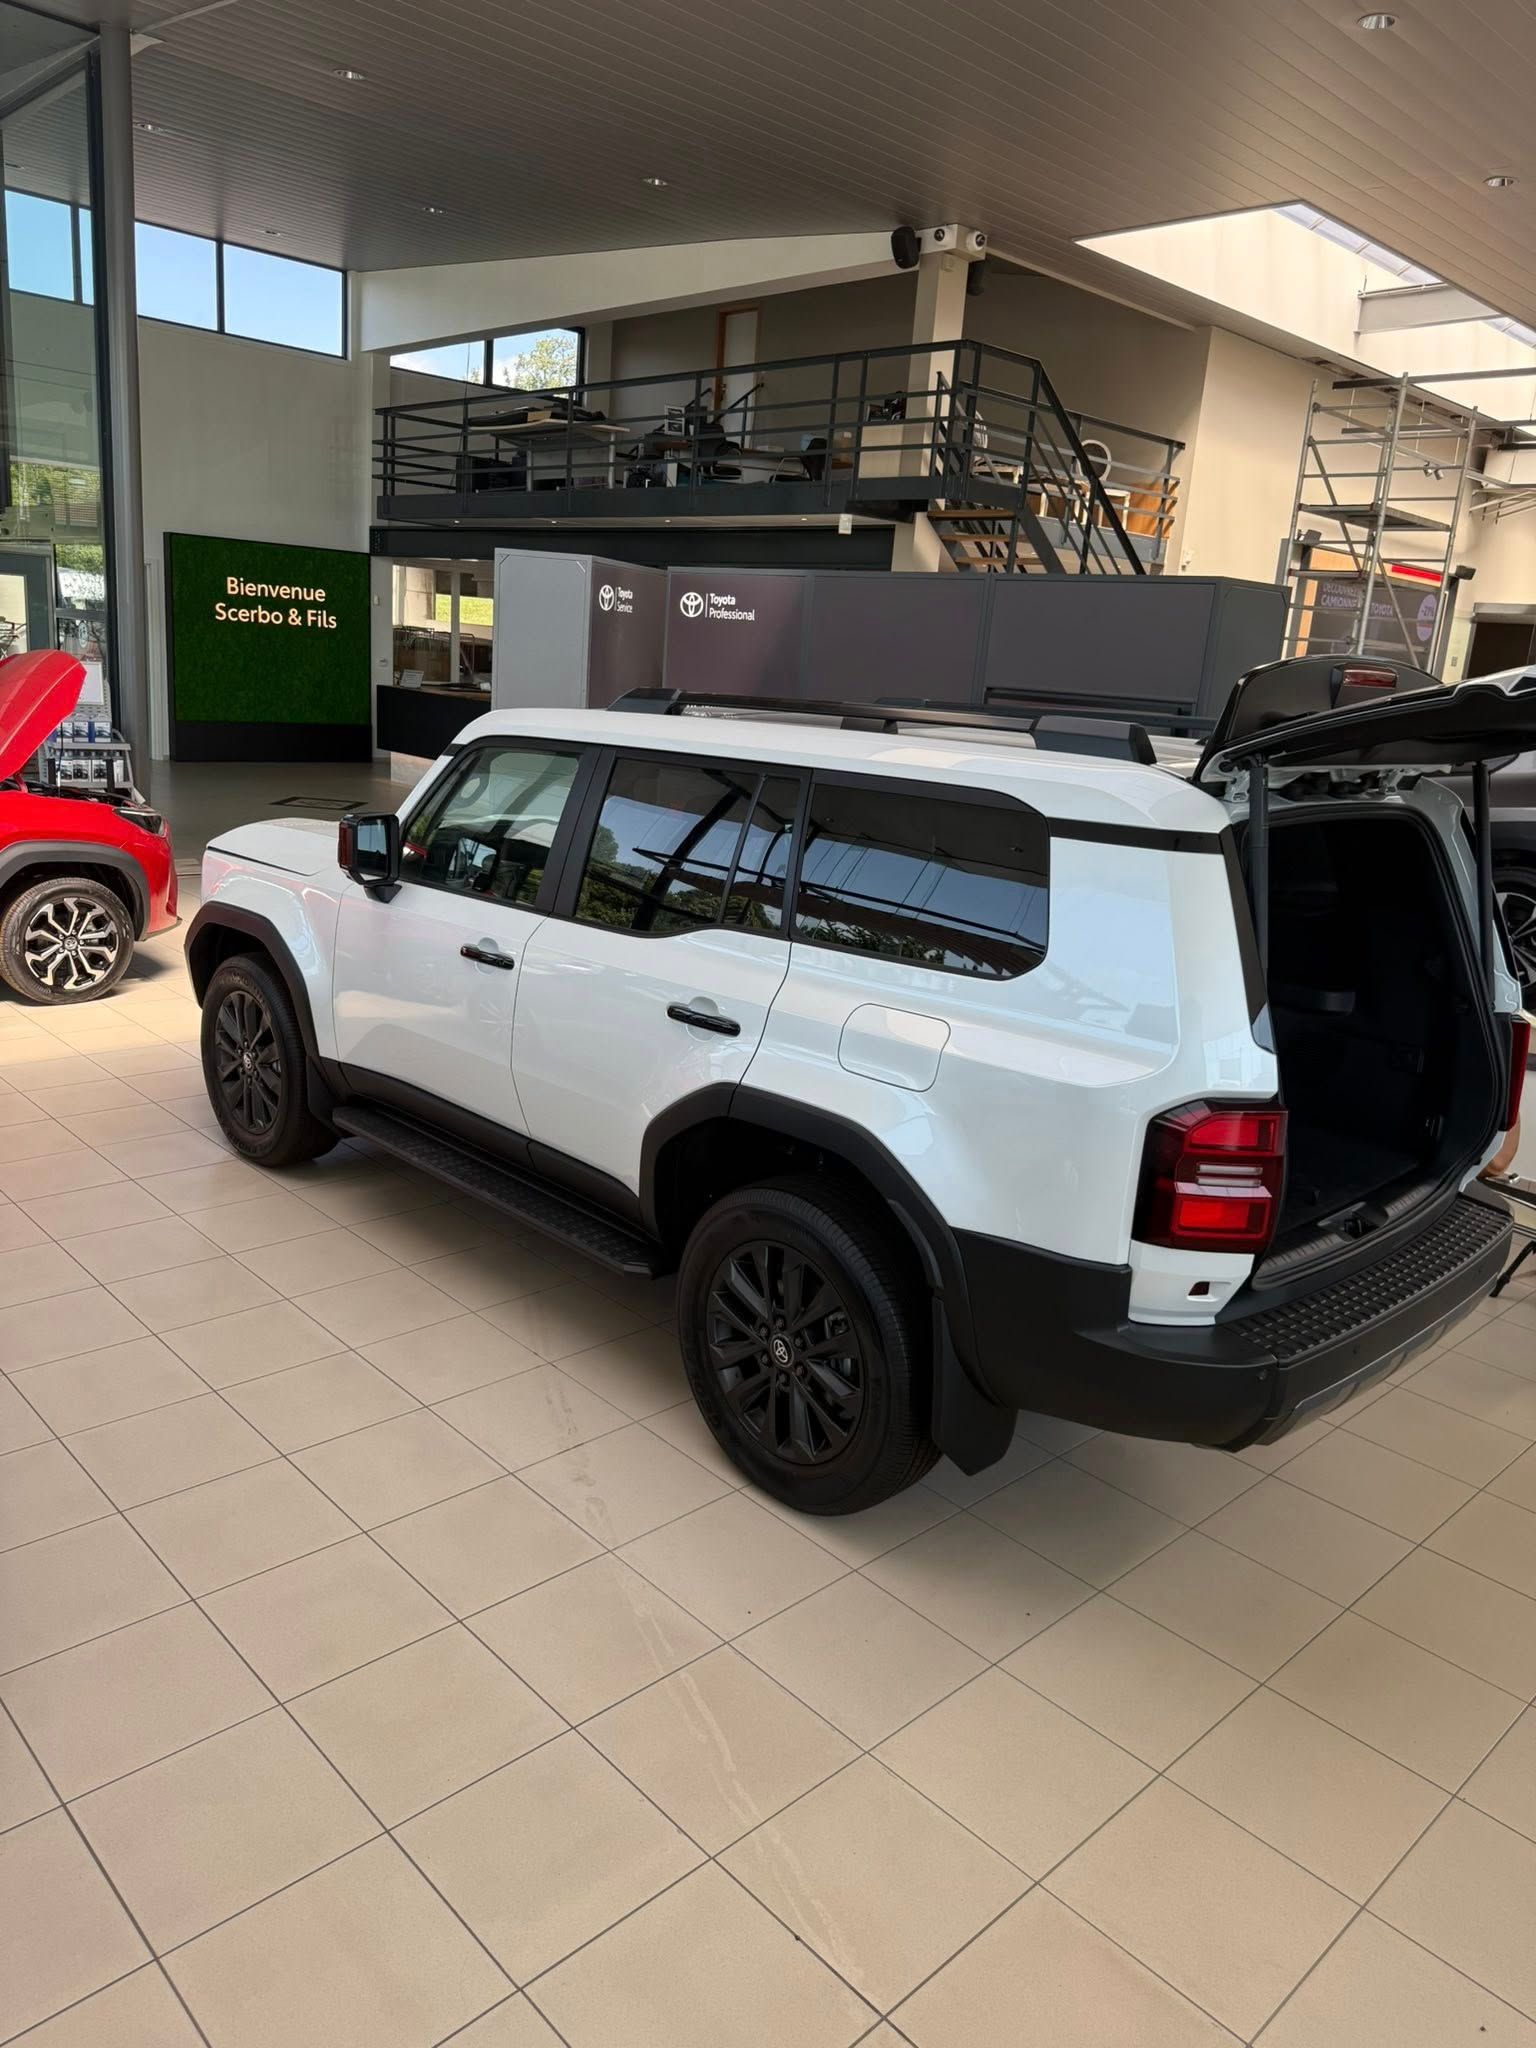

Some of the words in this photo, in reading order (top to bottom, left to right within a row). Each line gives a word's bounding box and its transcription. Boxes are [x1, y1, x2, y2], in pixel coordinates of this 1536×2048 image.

[226, 576, 326, 602] Bienvenue
[617, 586, 633, 601] Toyota
[616, 600, 633, 613] Service
[709, 593, 736, 607] Toyota
[215, 602, 283, 625] Scerbo
[287, 608, 302, 626] &
[306, 609, 337, 629] Fils
[708, 607, 755, 621] Professional
